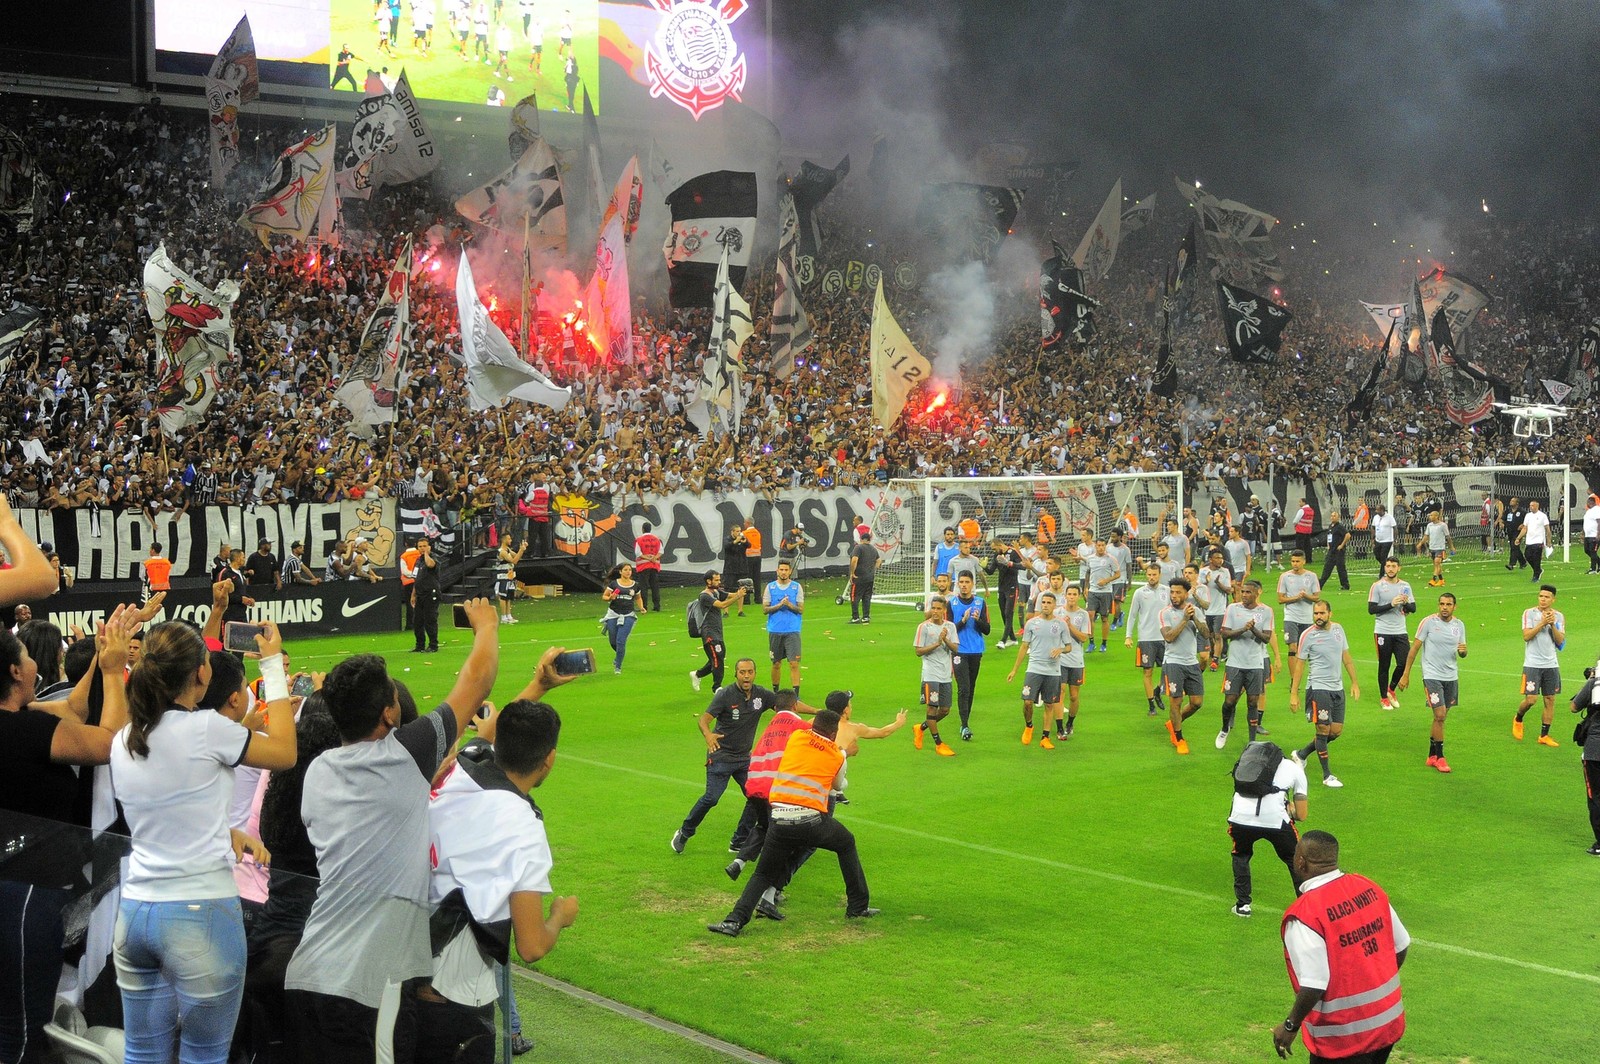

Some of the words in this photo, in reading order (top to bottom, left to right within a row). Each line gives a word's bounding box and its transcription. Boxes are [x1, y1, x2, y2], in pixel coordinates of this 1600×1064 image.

[687, 68, 709, 78] 1910
[418, 141, 434, 157] 12
[205, 503, 341, 575] NOVE
[610, 496, 852, 564] CAMISA
[1352, 888, 1378, 909] WHITE
